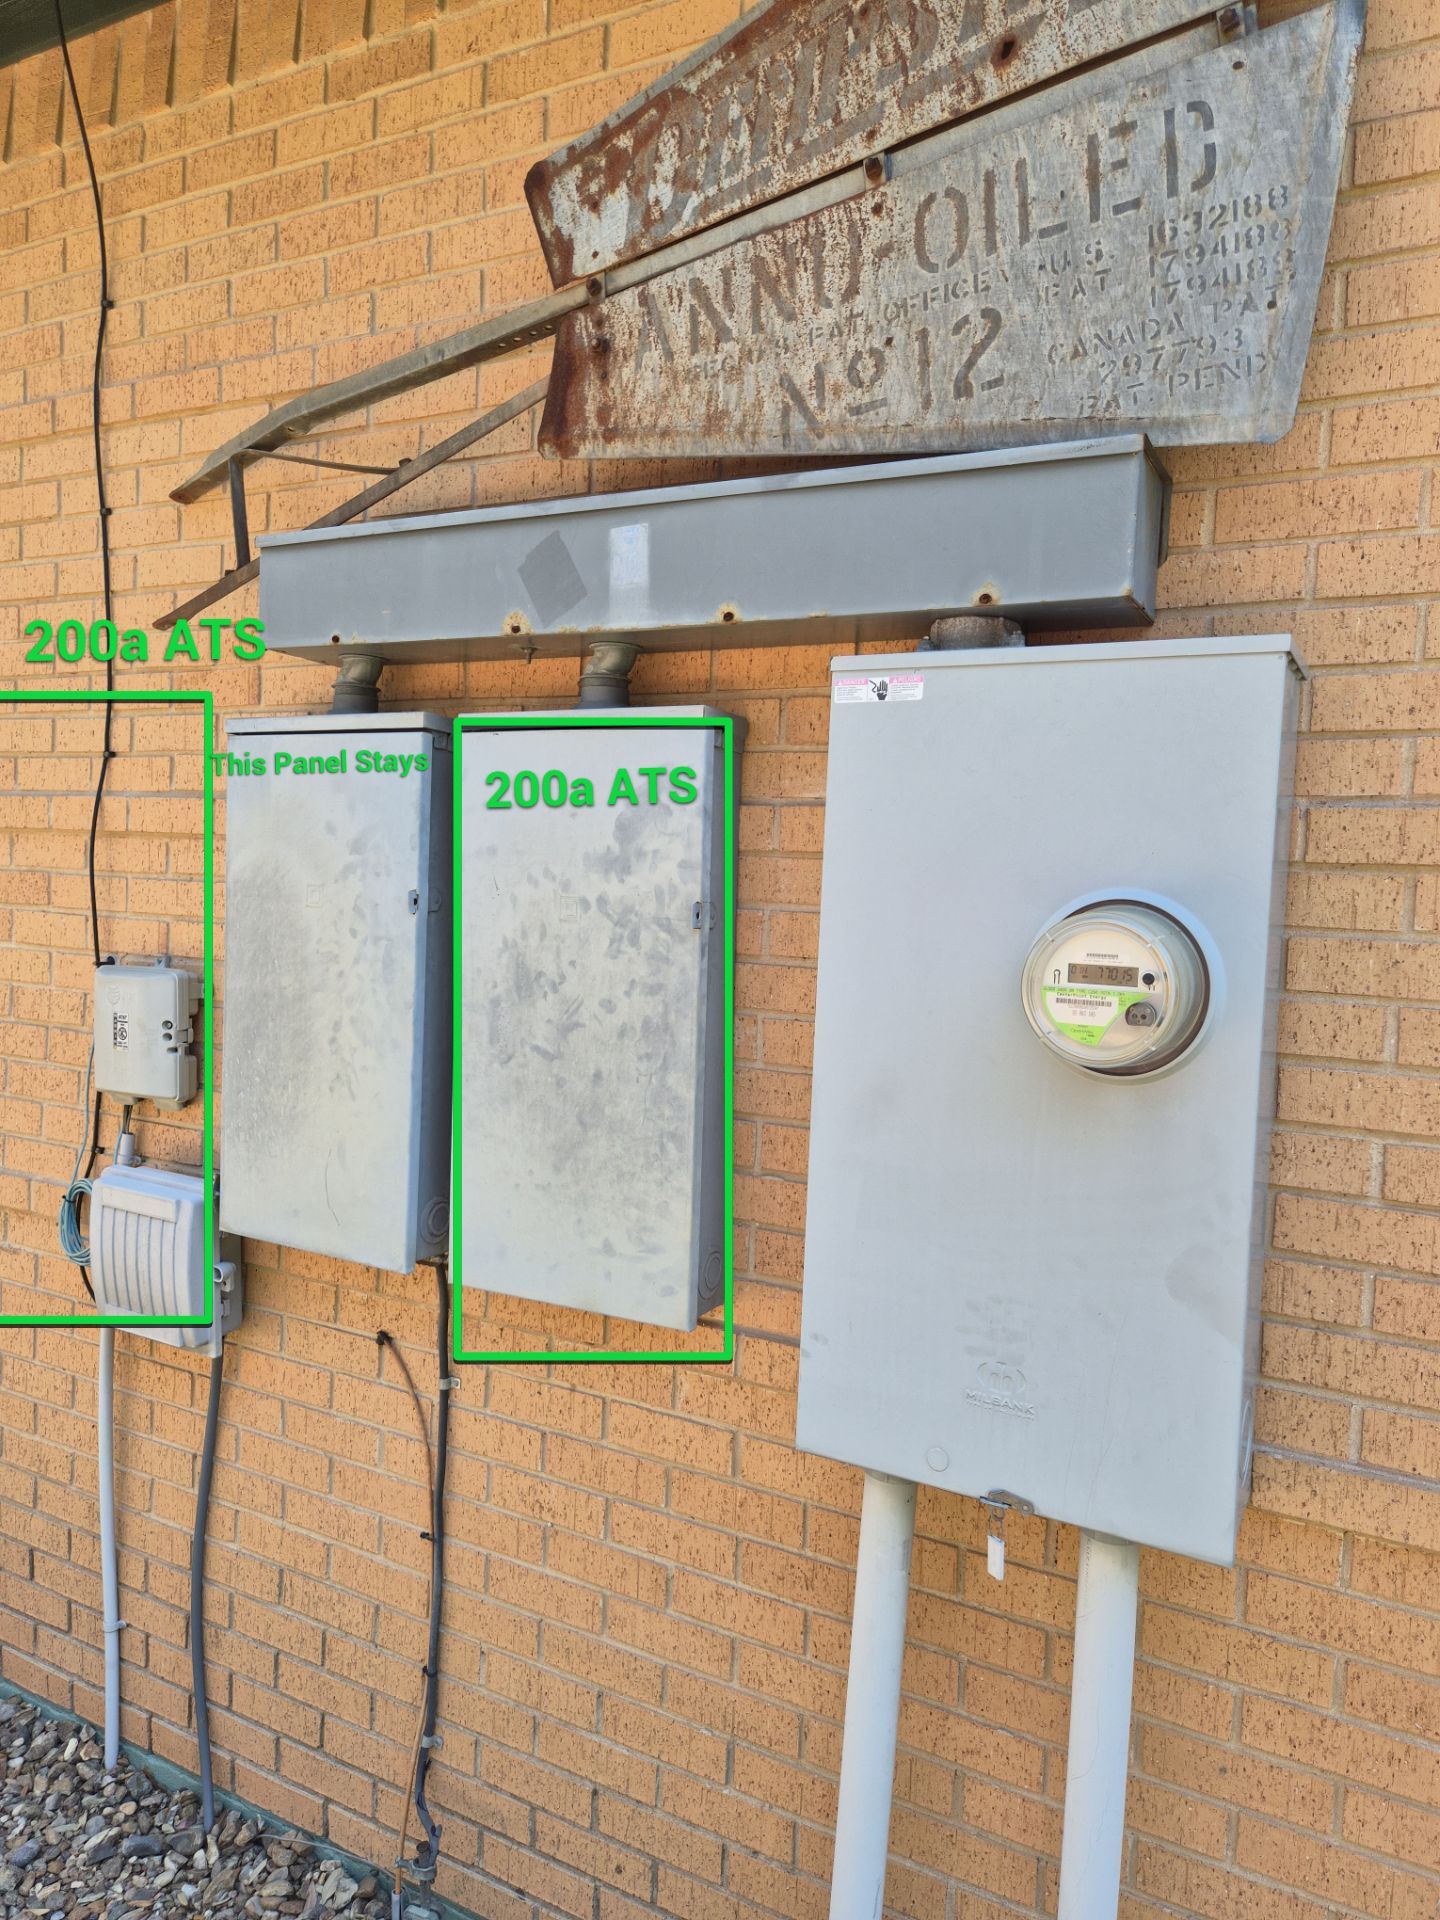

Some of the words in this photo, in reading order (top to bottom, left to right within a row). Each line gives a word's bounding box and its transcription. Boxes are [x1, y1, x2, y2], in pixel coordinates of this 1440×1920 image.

[634, 100, 1217, 372] ANNU-OILED
[914, 306, 1004, 411] 12
[1047, 312, 1184, 366] CANADA
